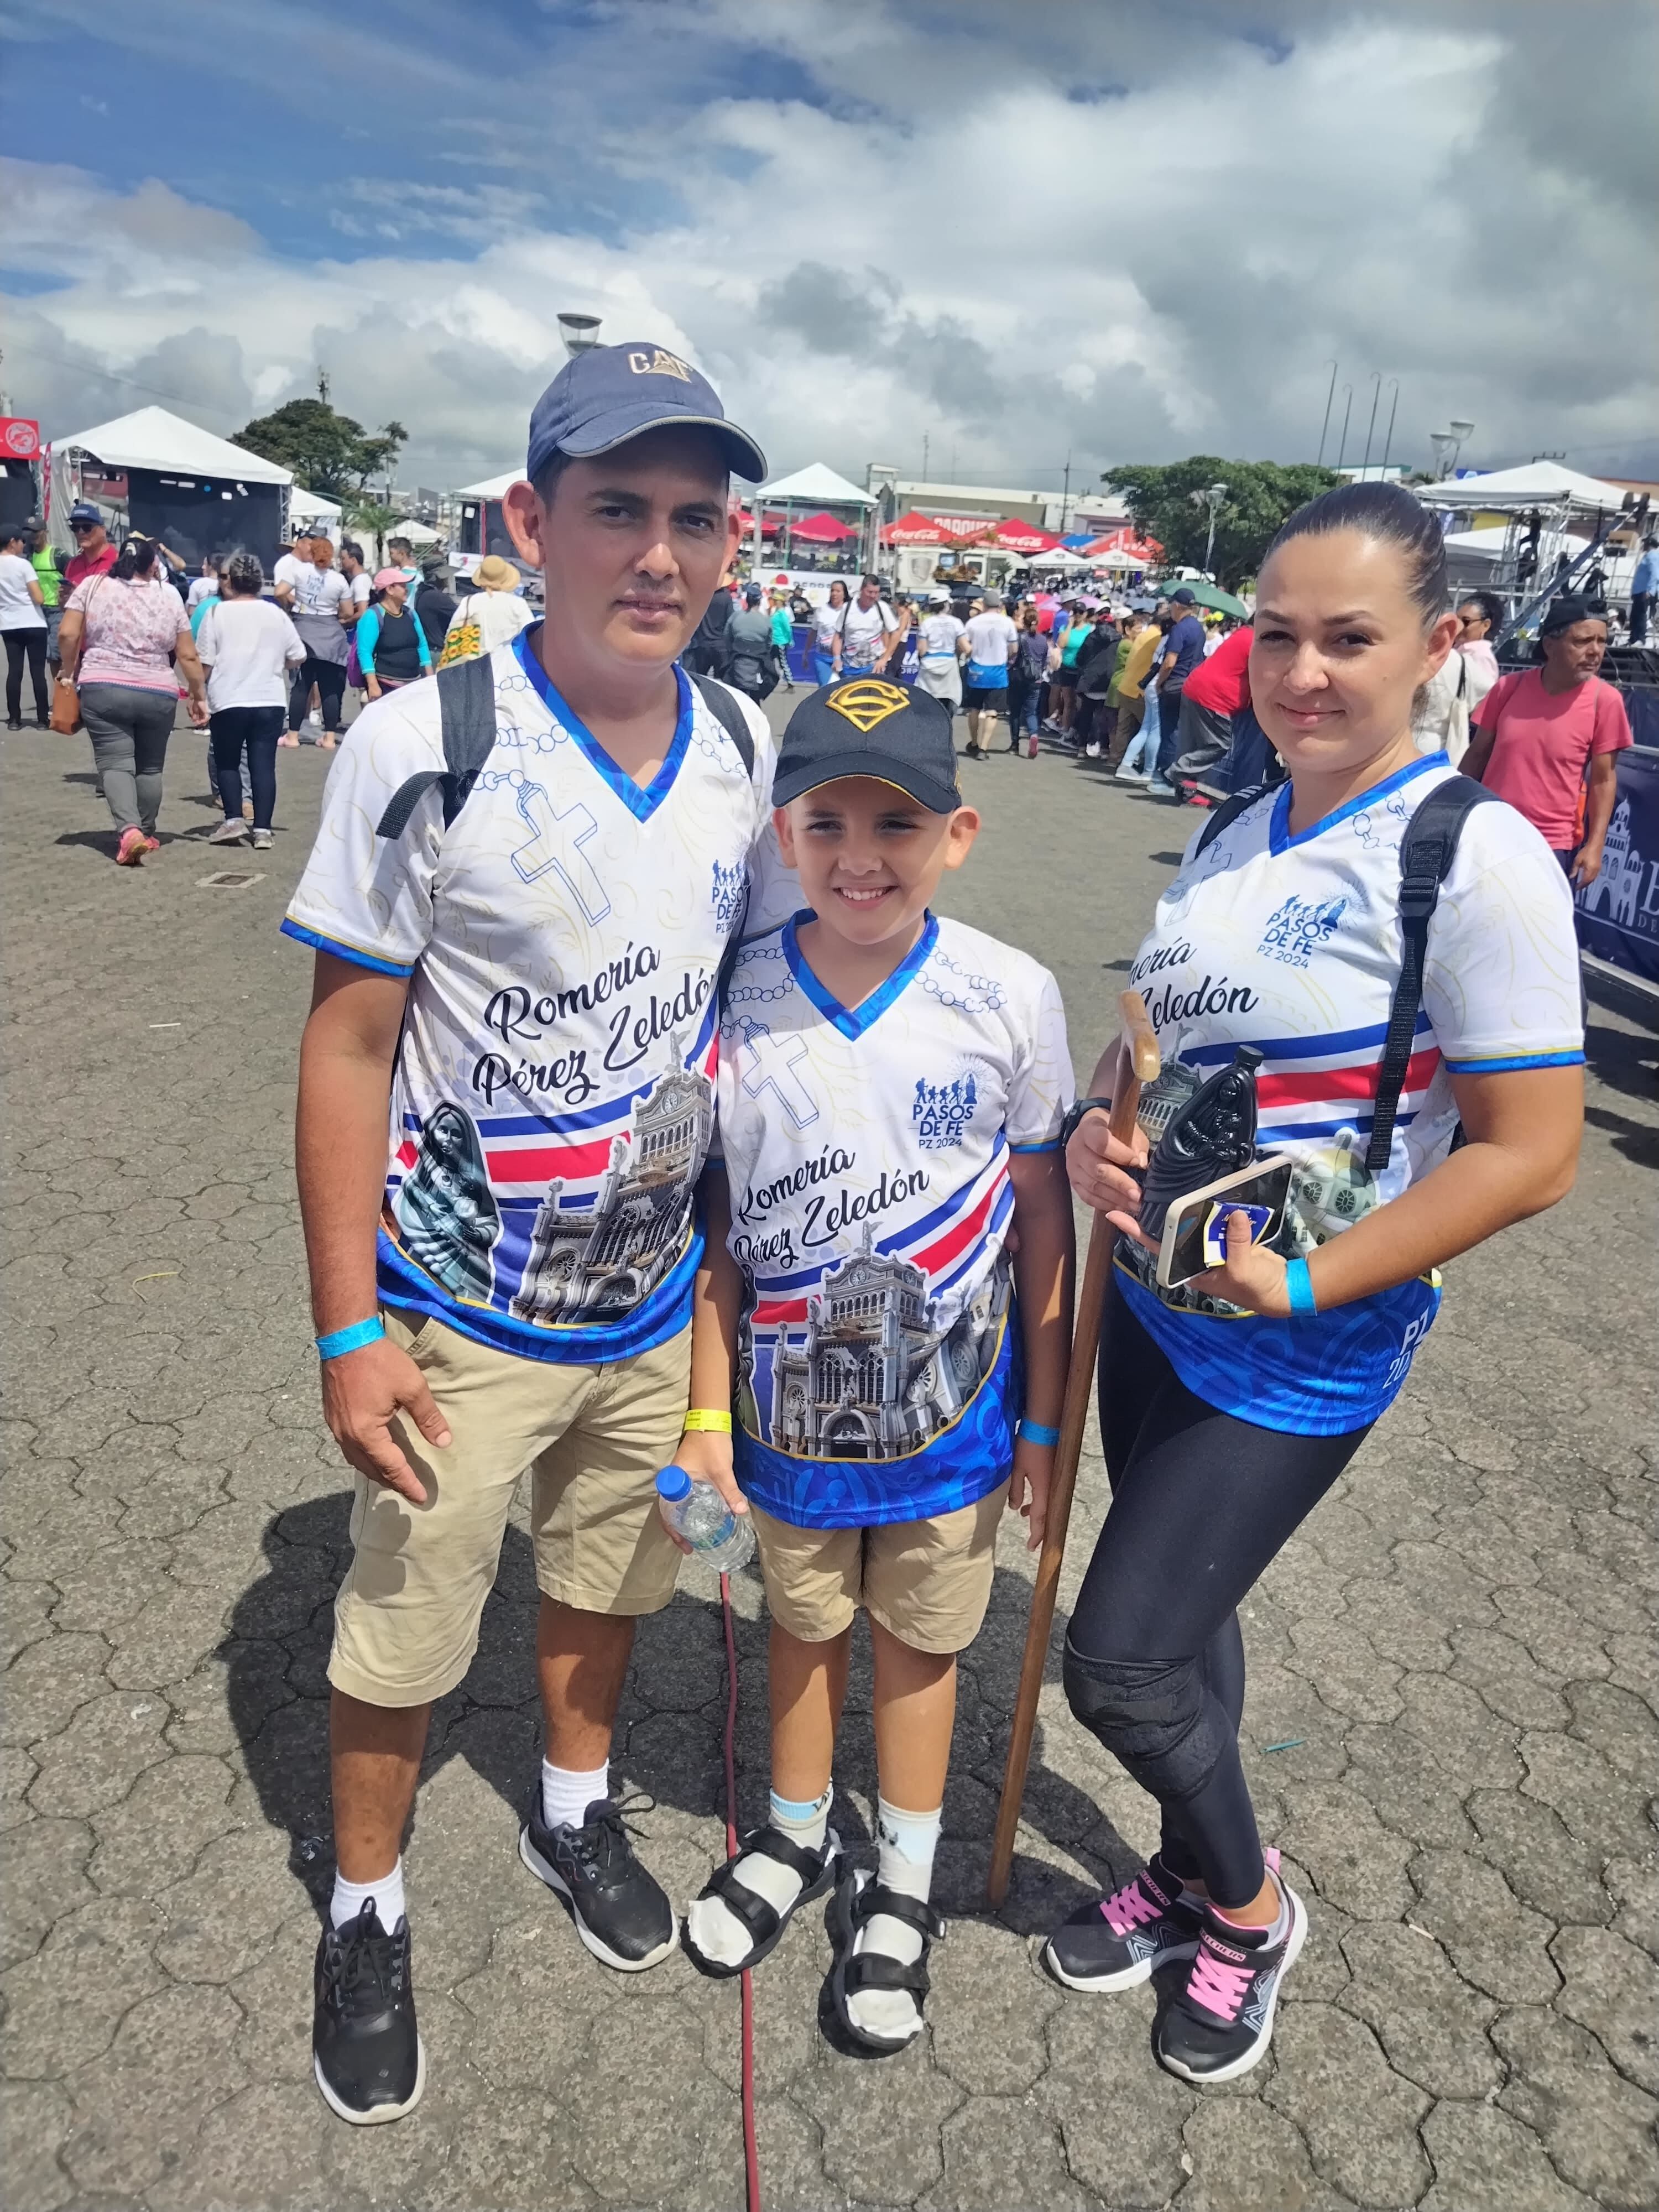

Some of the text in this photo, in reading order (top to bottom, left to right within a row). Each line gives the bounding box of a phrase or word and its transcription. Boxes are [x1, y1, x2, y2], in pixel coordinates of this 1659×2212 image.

[628, 349, 692, 384] CAT
[712, 886, 744, 904] PASO
[717, 904, 733, 920] DE
[1266, 912, 1333, 941] PASOS
[1264, 928, 1317, 956] DE FE
[1256, 945, 1309, 969] PZ 2024
[484, 941, 661, 1045] Romería
[472, 967, 714, 1107] Pérez Zeledó
[912, 1104, 974, 1120] PASOS
[919, 1120, 964, 1136] DE FE
[919, 1138, 963, 1149] PZ 2024
[801, 1168, 930, 1248] Zeledón
[1399, 1306, 1431, 1357] PZ
